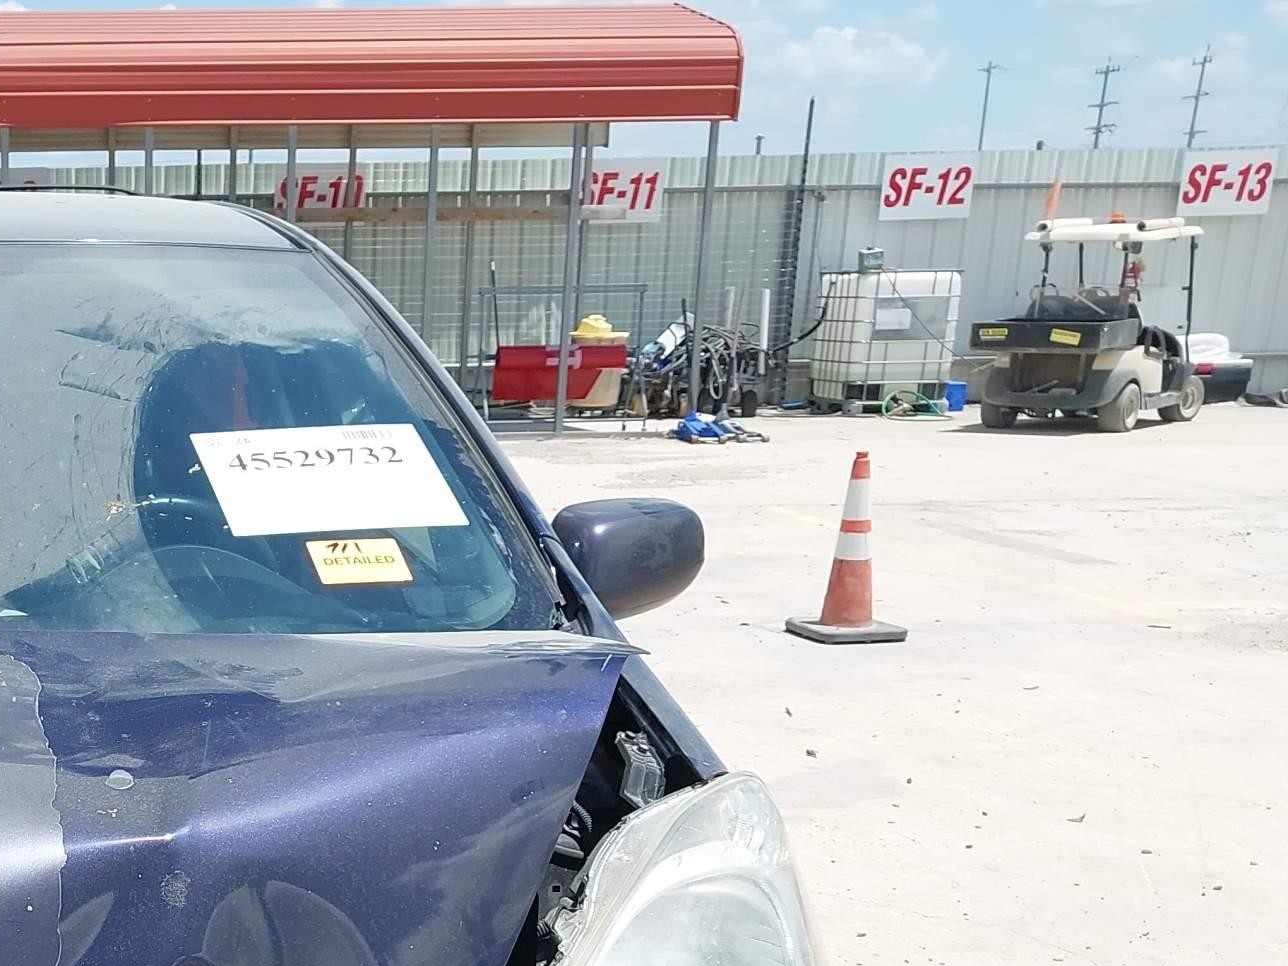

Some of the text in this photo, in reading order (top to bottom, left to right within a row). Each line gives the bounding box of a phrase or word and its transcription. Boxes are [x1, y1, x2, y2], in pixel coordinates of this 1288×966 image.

[883, 166, 972, 207] SF-12
[1182, 162, 1272, 204] SF-13
[228, 446, 403, 471] 45529732
[323, 555, 395, 566] DETAILED
